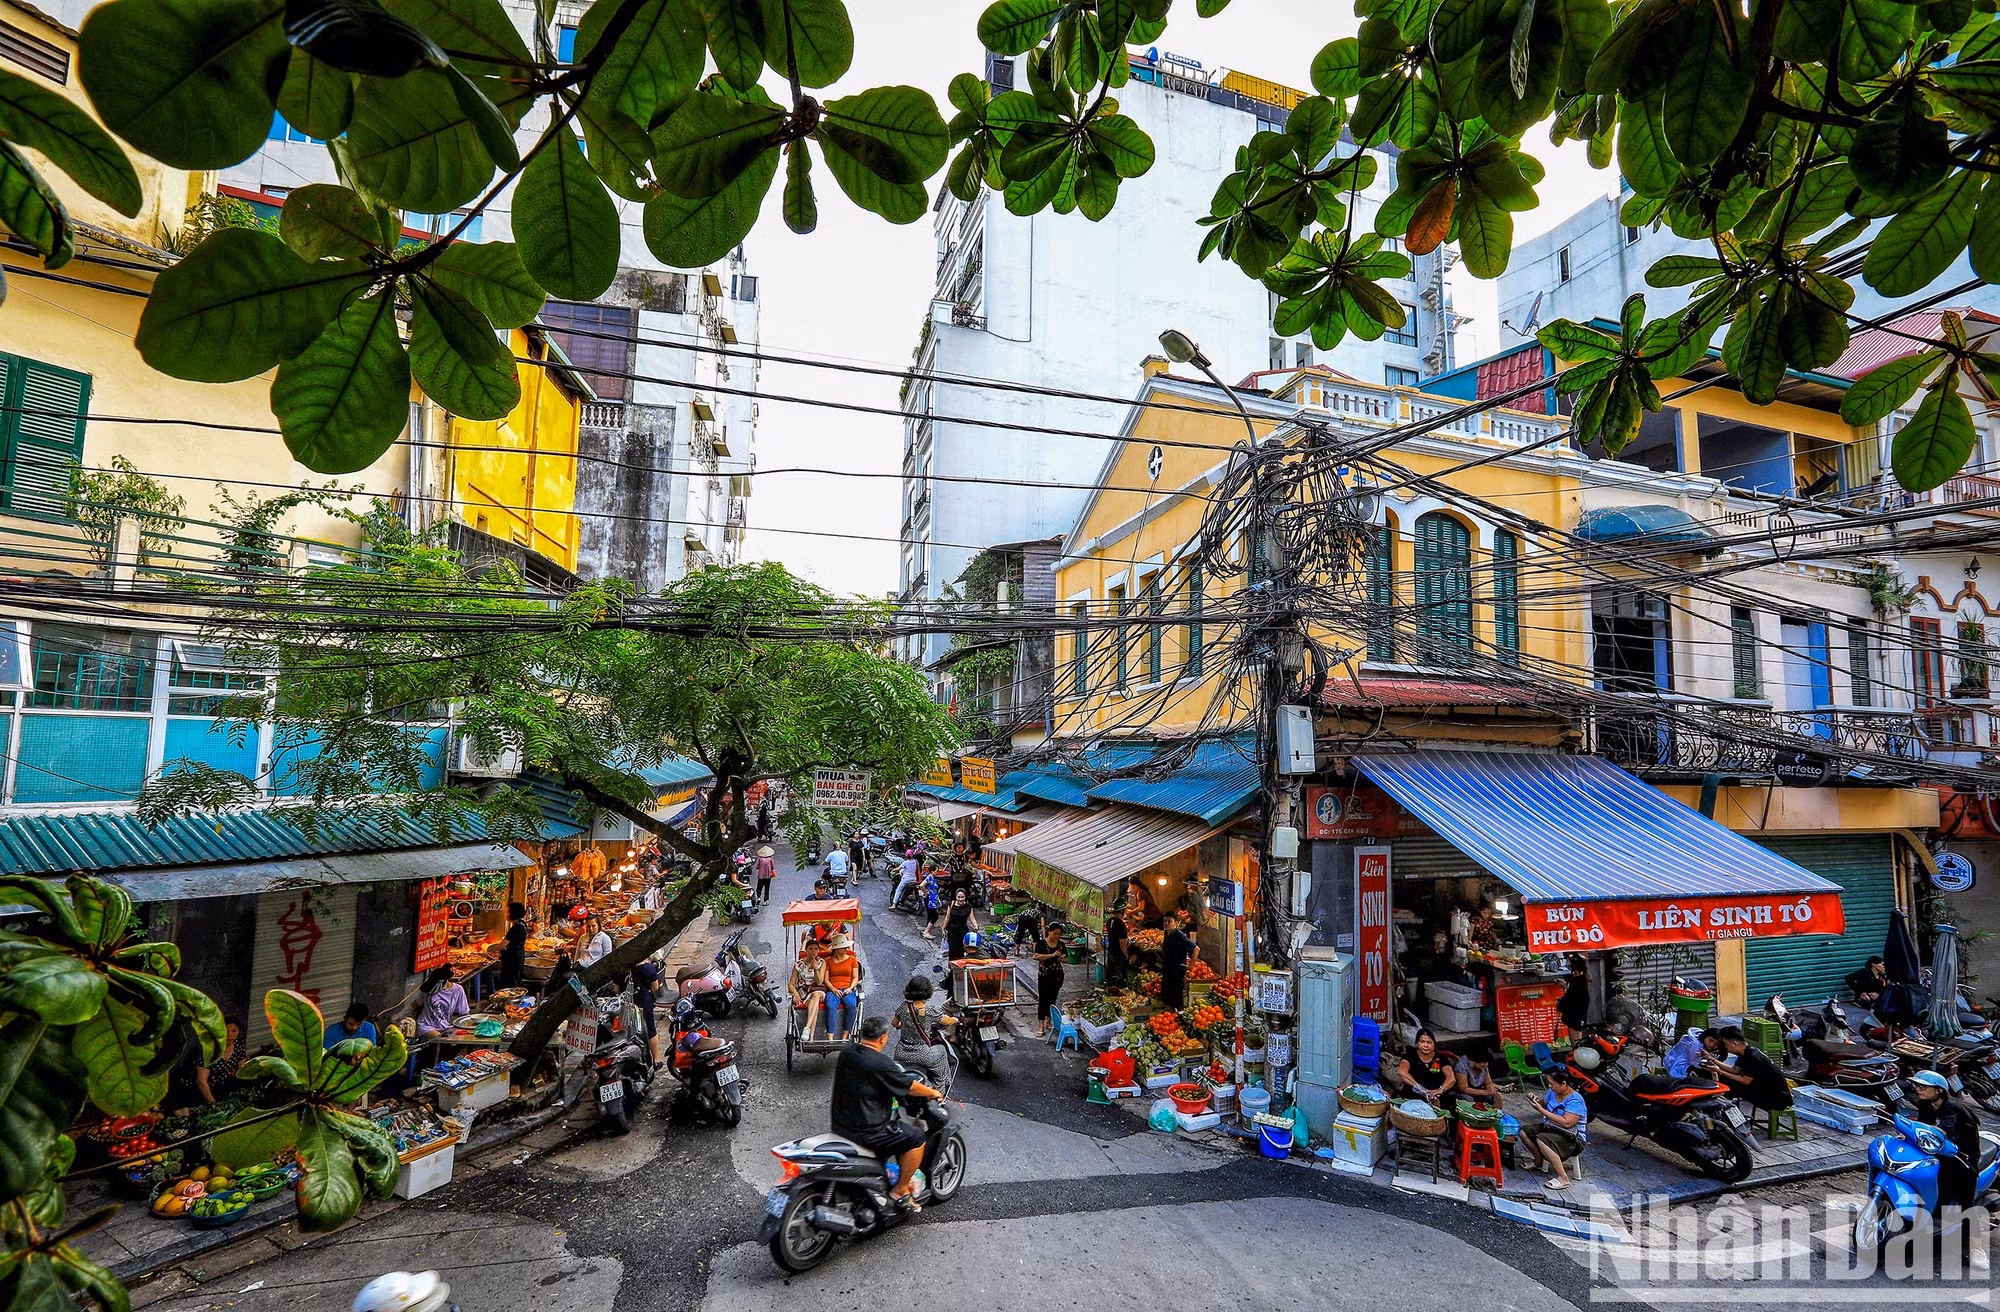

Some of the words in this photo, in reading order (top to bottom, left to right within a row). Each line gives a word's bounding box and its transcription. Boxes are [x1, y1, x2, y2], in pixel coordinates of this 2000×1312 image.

[817, 771, 845, 780] MUA
[1777, 764, 1822, 775] perfetto
[817, 780, 834, 789] BÀN
[1367, 837, 1376, 845] 17
[1361, 858, 1385, 877] Liên
[1939, 867, 1968, 878] arett
[1362, 891, 1386, 928] SINH
[1546, 904, 1585, 923] BÚN
[1638, 904, 1702, 930] LIÊN
[1709, 904, 1773, 926] SINH
[1778, 896, 1813, 922] TỐ
[1532, 926, 1571, 945] PHÚ
[1576, 925, 1604, 943] ĐÔ
[1705, 929, 1715, 939] 17
[1717, 928, 1733, 939] GIA
[1365, 933, 1384, 987] TỐ
[1368, 998, 1380, 1009] 17
[580, 1040, 594, 1054] BIỆT
